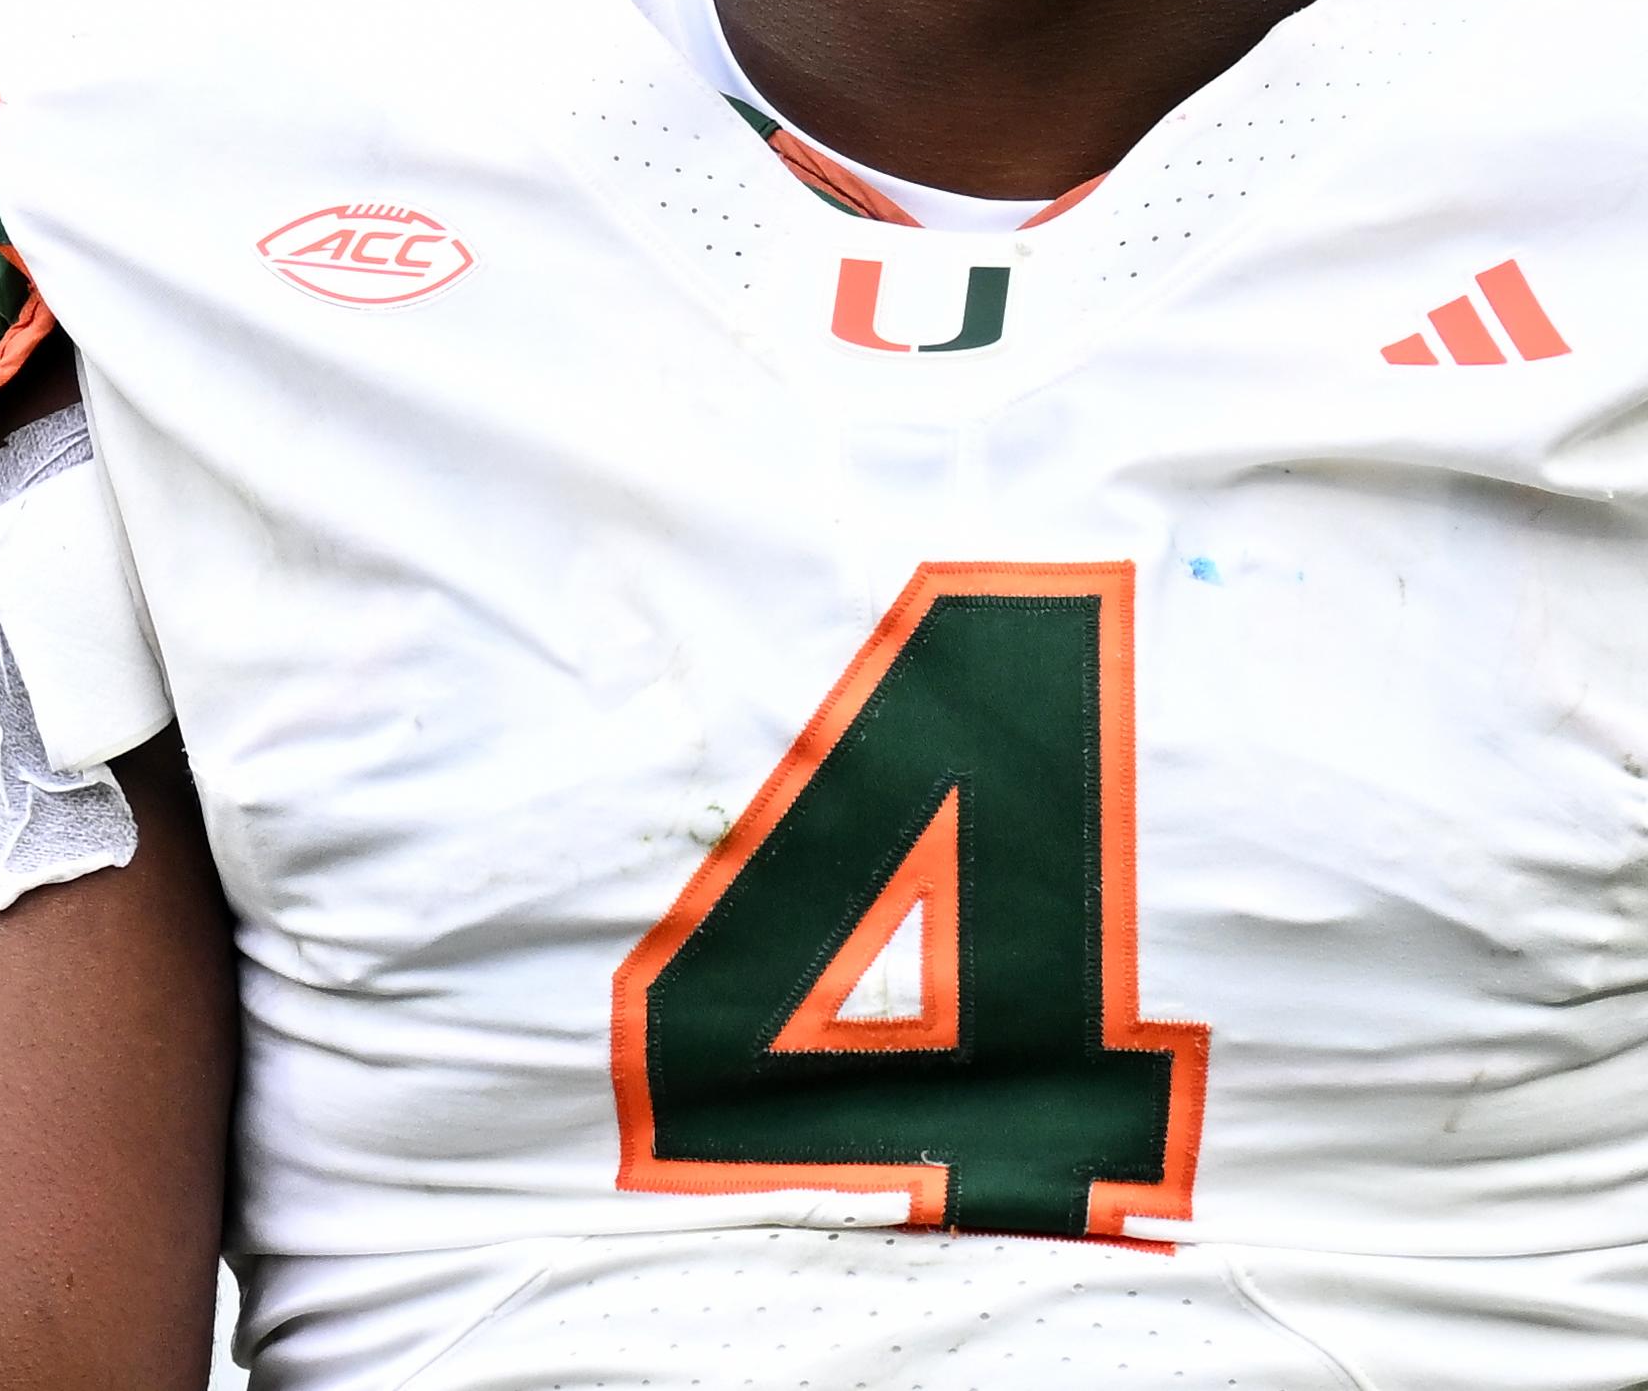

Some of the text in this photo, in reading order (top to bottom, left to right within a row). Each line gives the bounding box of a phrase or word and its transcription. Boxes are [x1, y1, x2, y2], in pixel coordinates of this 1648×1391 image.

[287, 228, 448, 268] ACC
[830, 257, 1011, 353] U
[610, 559, 1212, 1255] 4
